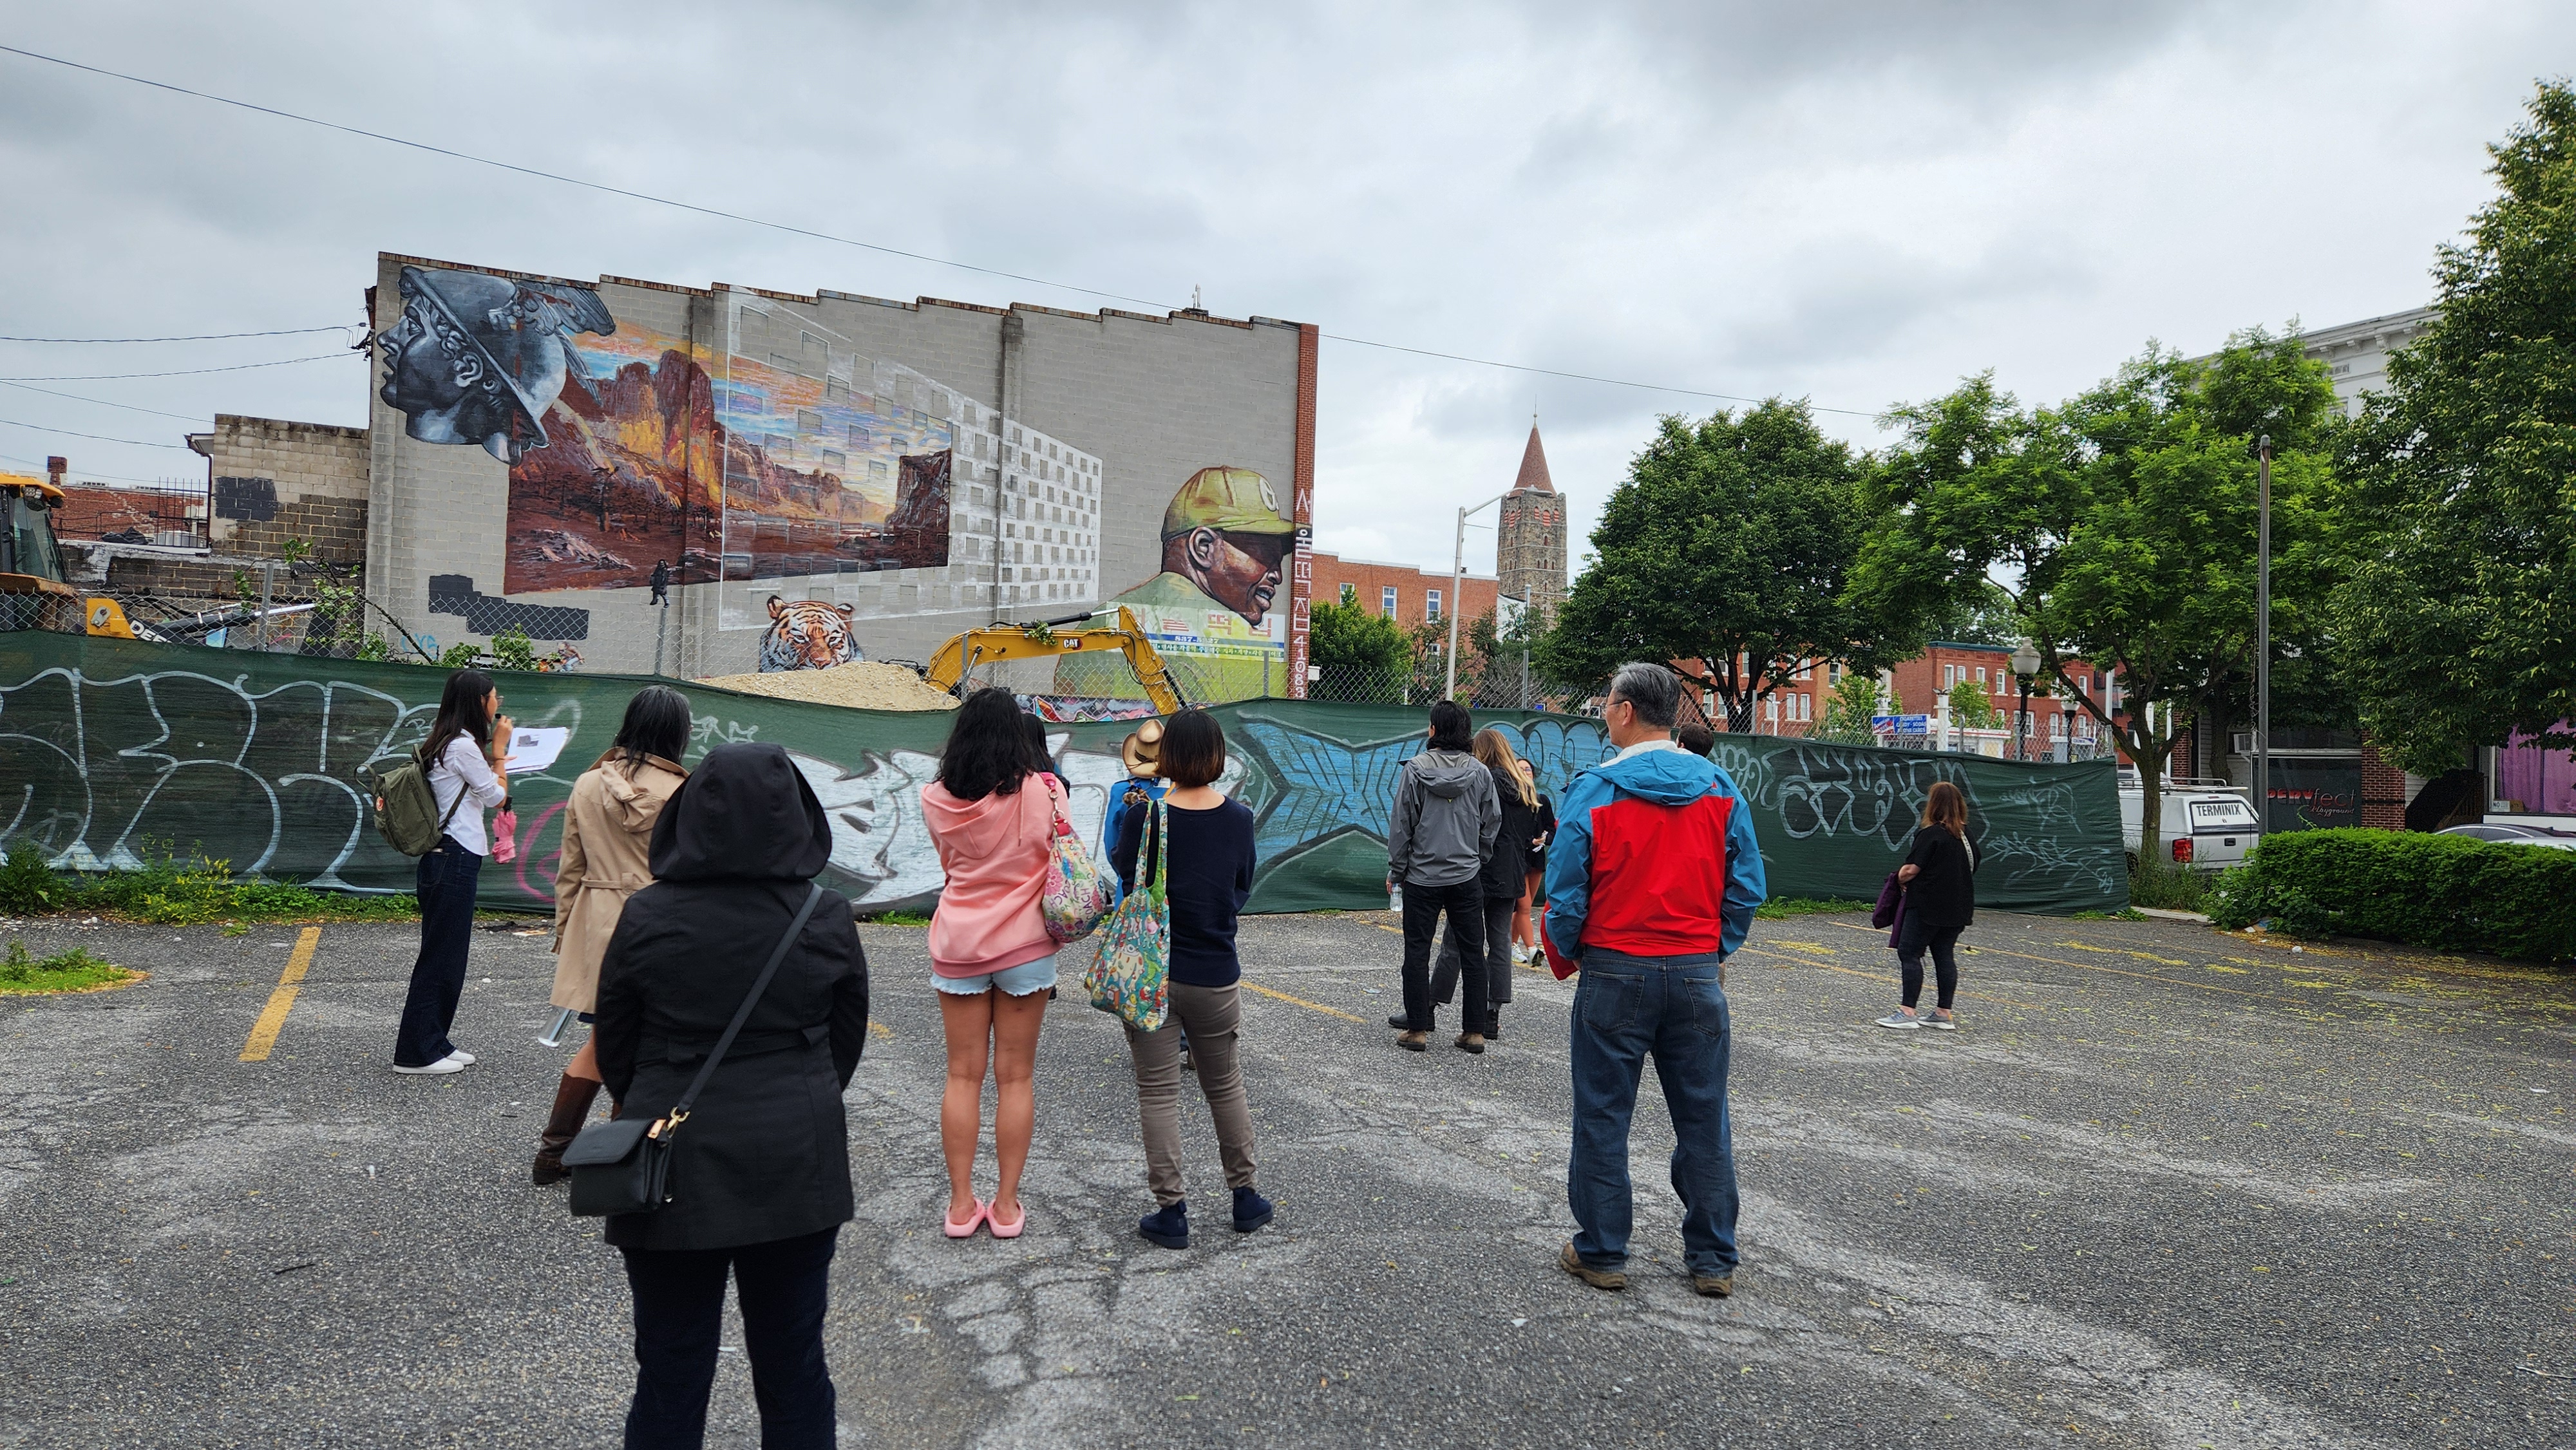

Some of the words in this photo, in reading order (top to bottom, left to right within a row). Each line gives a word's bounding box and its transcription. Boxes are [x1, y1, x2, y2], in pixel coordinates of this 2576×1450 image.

[1292, 487, 1314, 632] 서울떡집
[129, 620, 173, 643] DEE
[1063, 639, 1079, 648] CAT
[2196, 804, 2242, 816] TERMINIX
[1080, 888, 1097, 920] COACH
